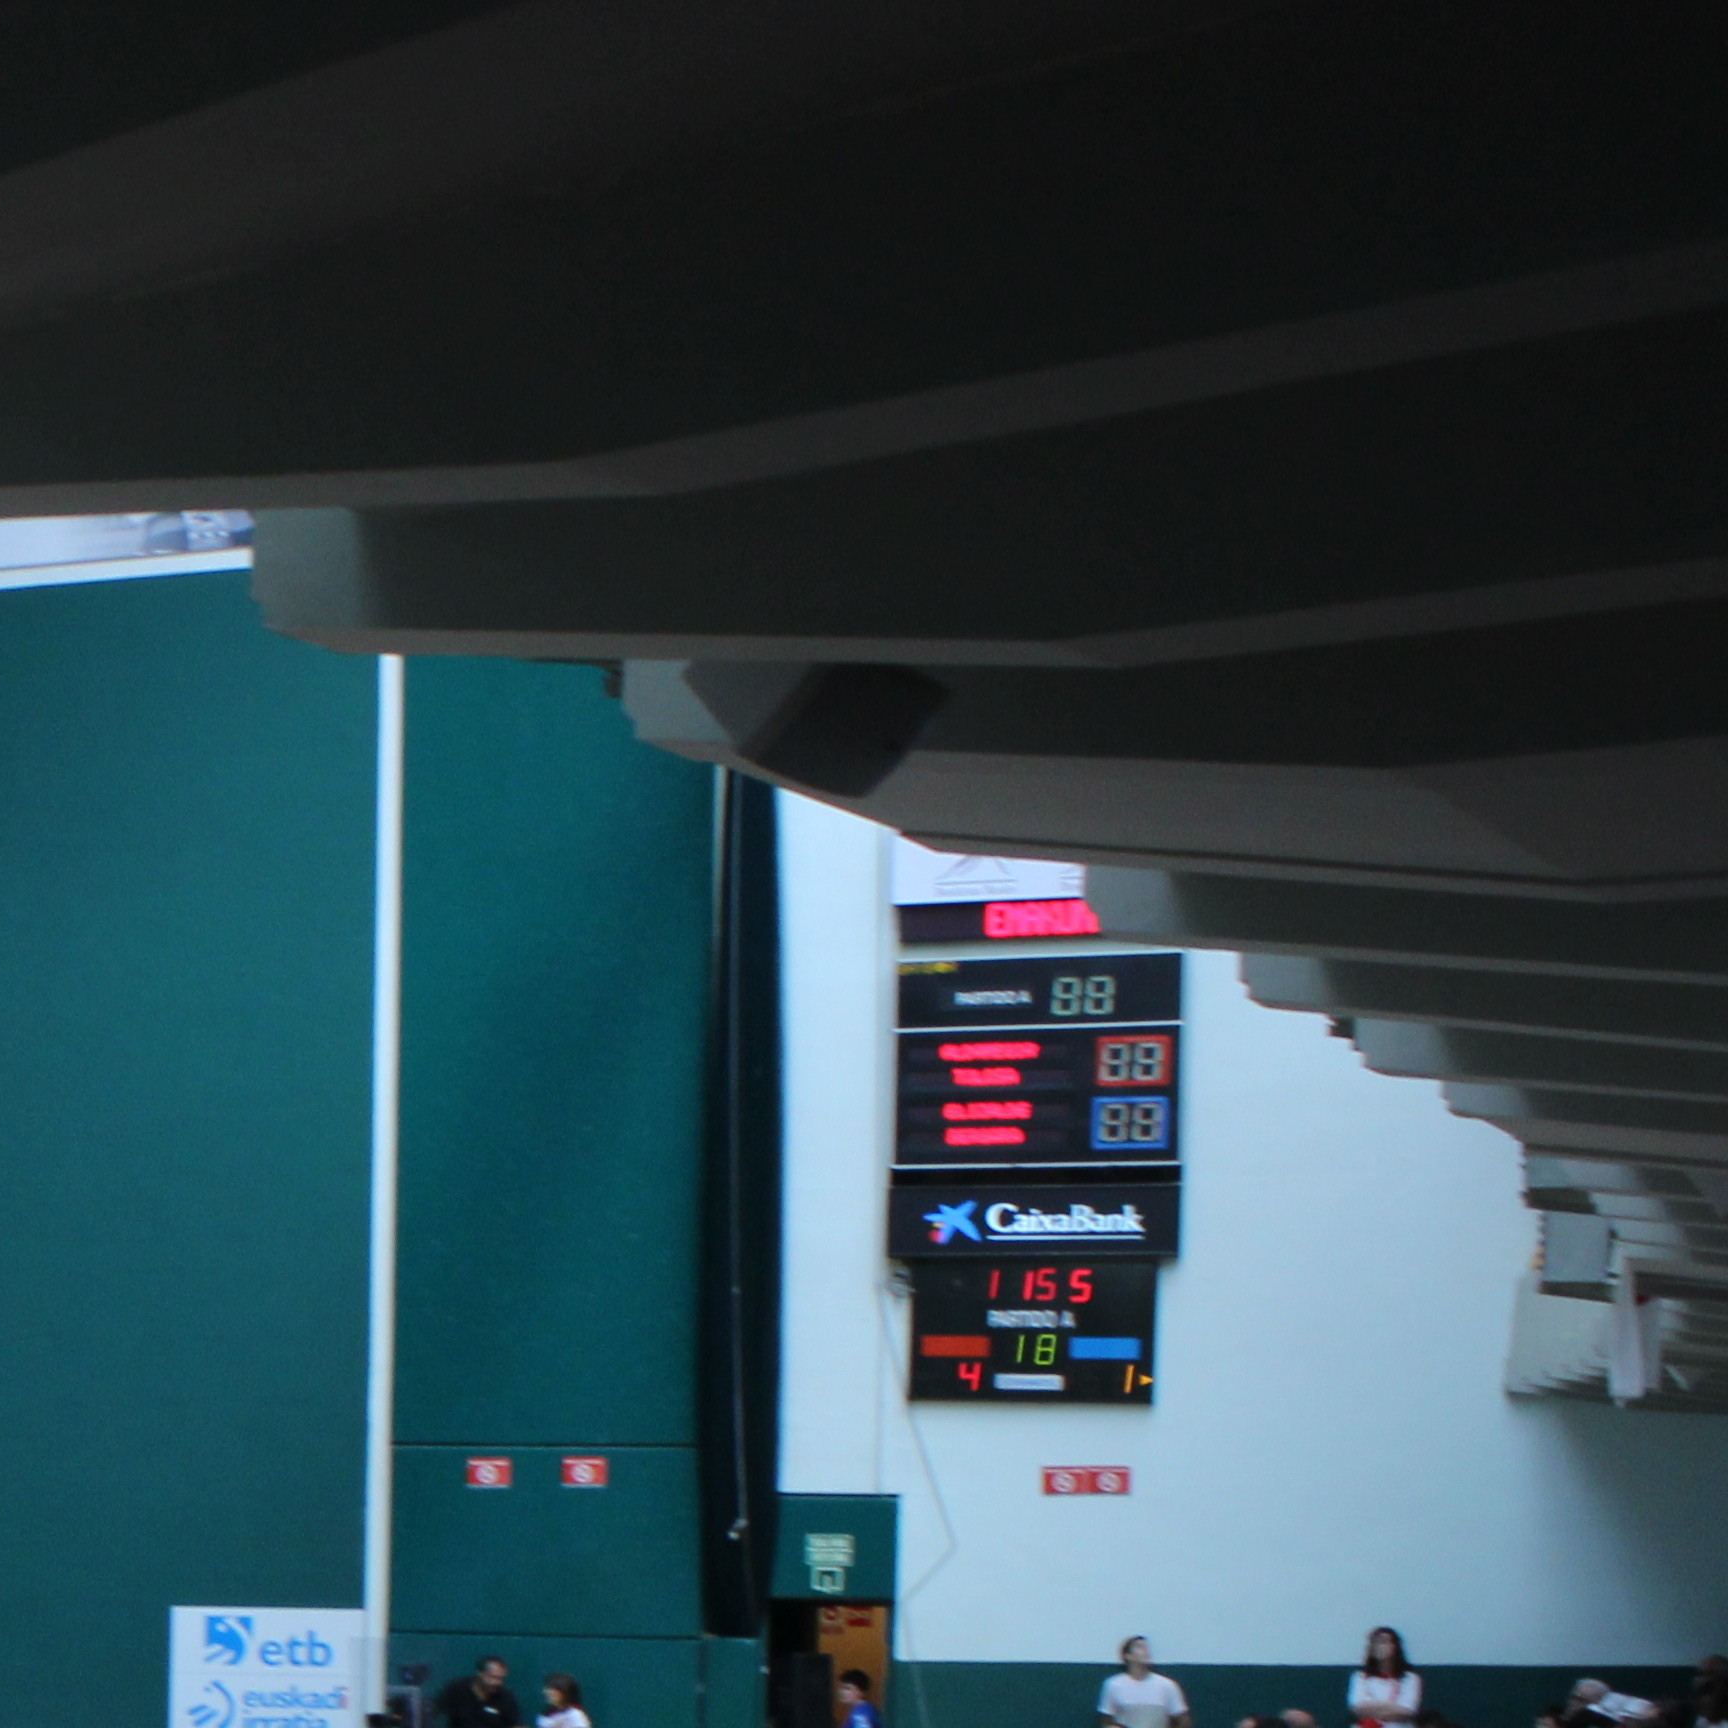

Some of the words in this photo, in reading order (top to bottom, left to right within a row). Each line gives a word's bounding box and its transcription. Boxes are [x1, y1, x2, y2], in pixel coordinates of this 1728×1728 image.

[984, 1202, 1146, 1234] CaixaBank
[957, 1362, 982, 1391] 4
[260, 1630, 333, 1667] etb
